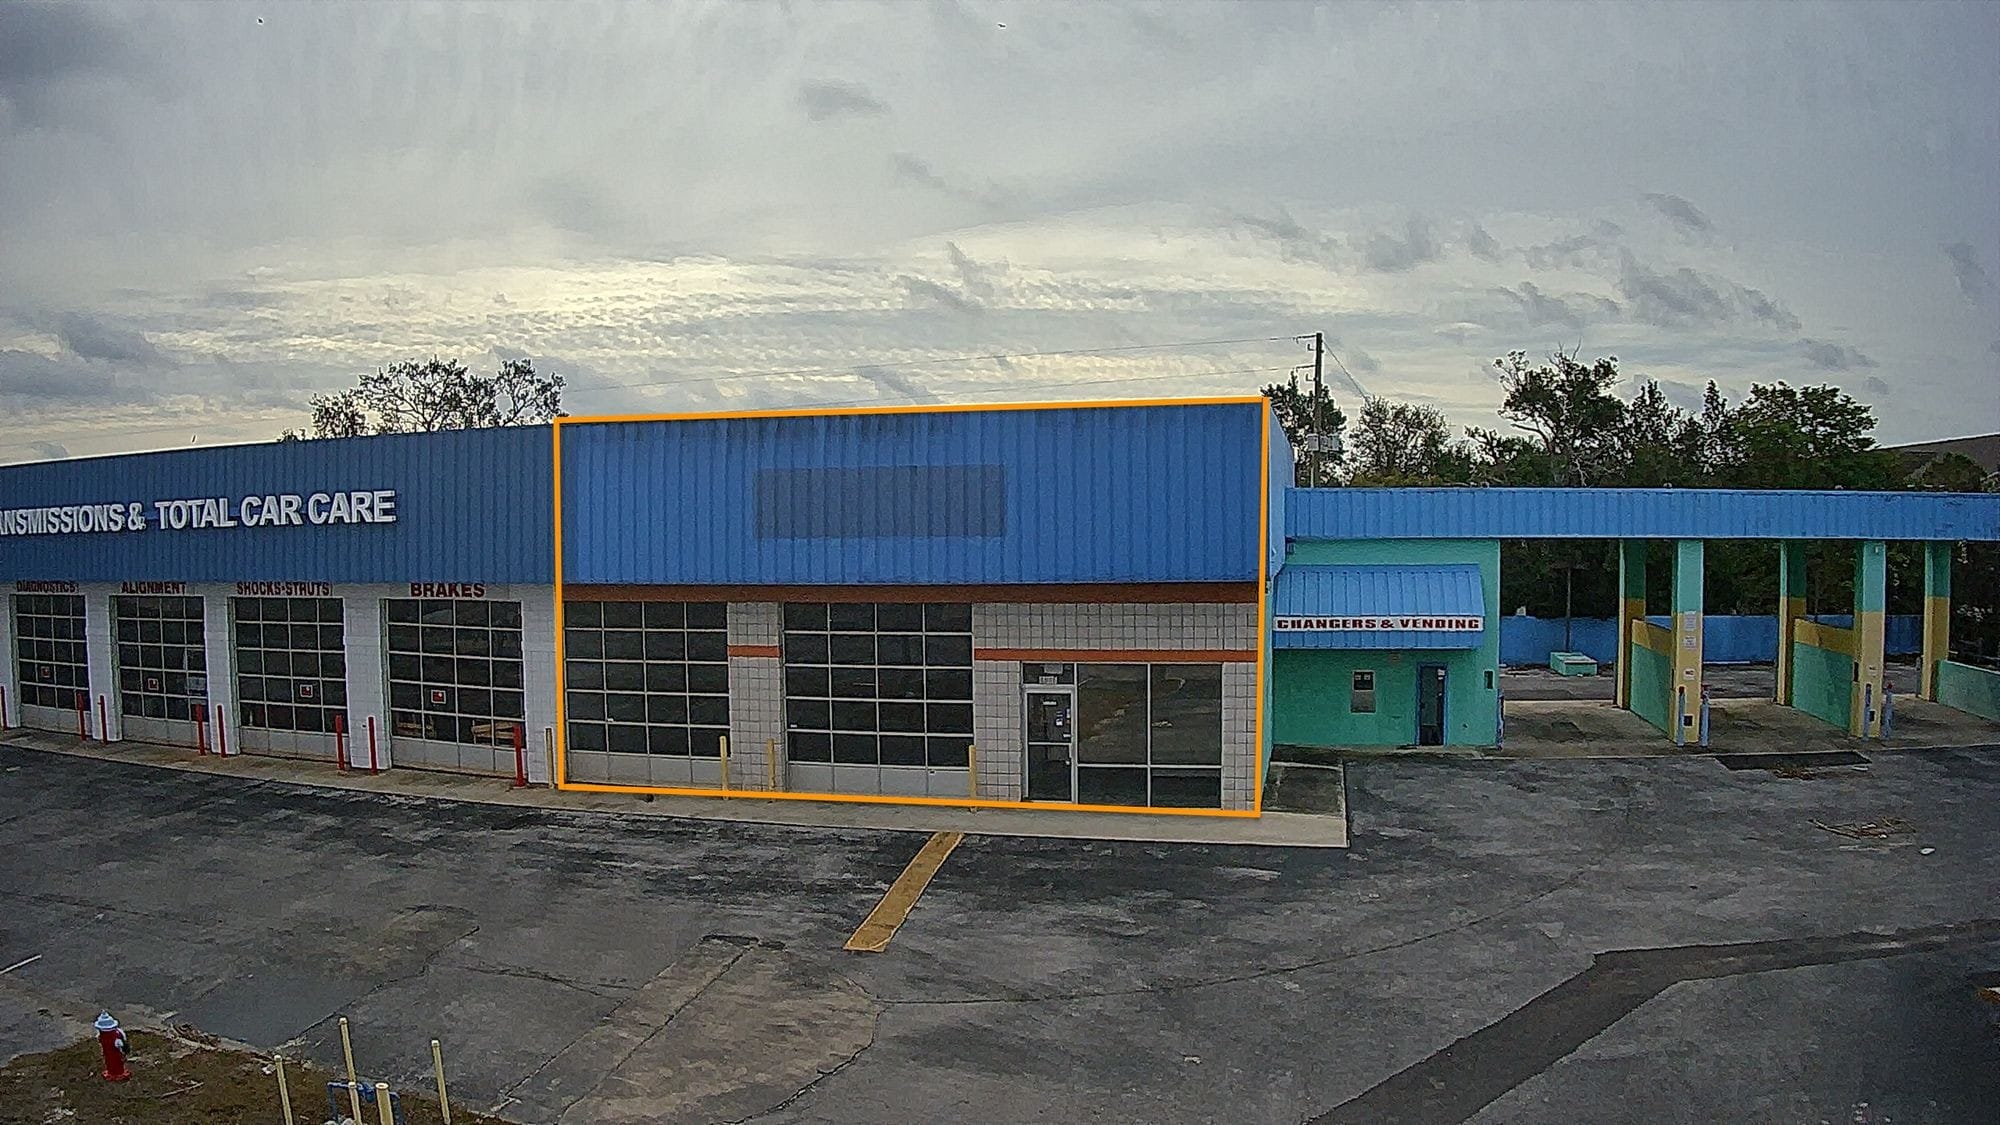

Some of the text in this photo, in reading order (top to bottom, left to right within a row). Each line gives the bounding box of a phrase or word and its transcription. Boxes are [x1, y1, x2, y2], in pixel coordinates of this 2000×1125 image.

[128, 502, 147, 531] &
[154, 498, 238, 530] TOTAL
[241, 494, 303, 527] CAR
[307, 489, 397, 525] CARE
[121, 581, 186, 594] ALIGNMENT
[410, 582, 485, 598] BRAKES
[1277, 618, 1480, 629] CHANGERS & VENDING
